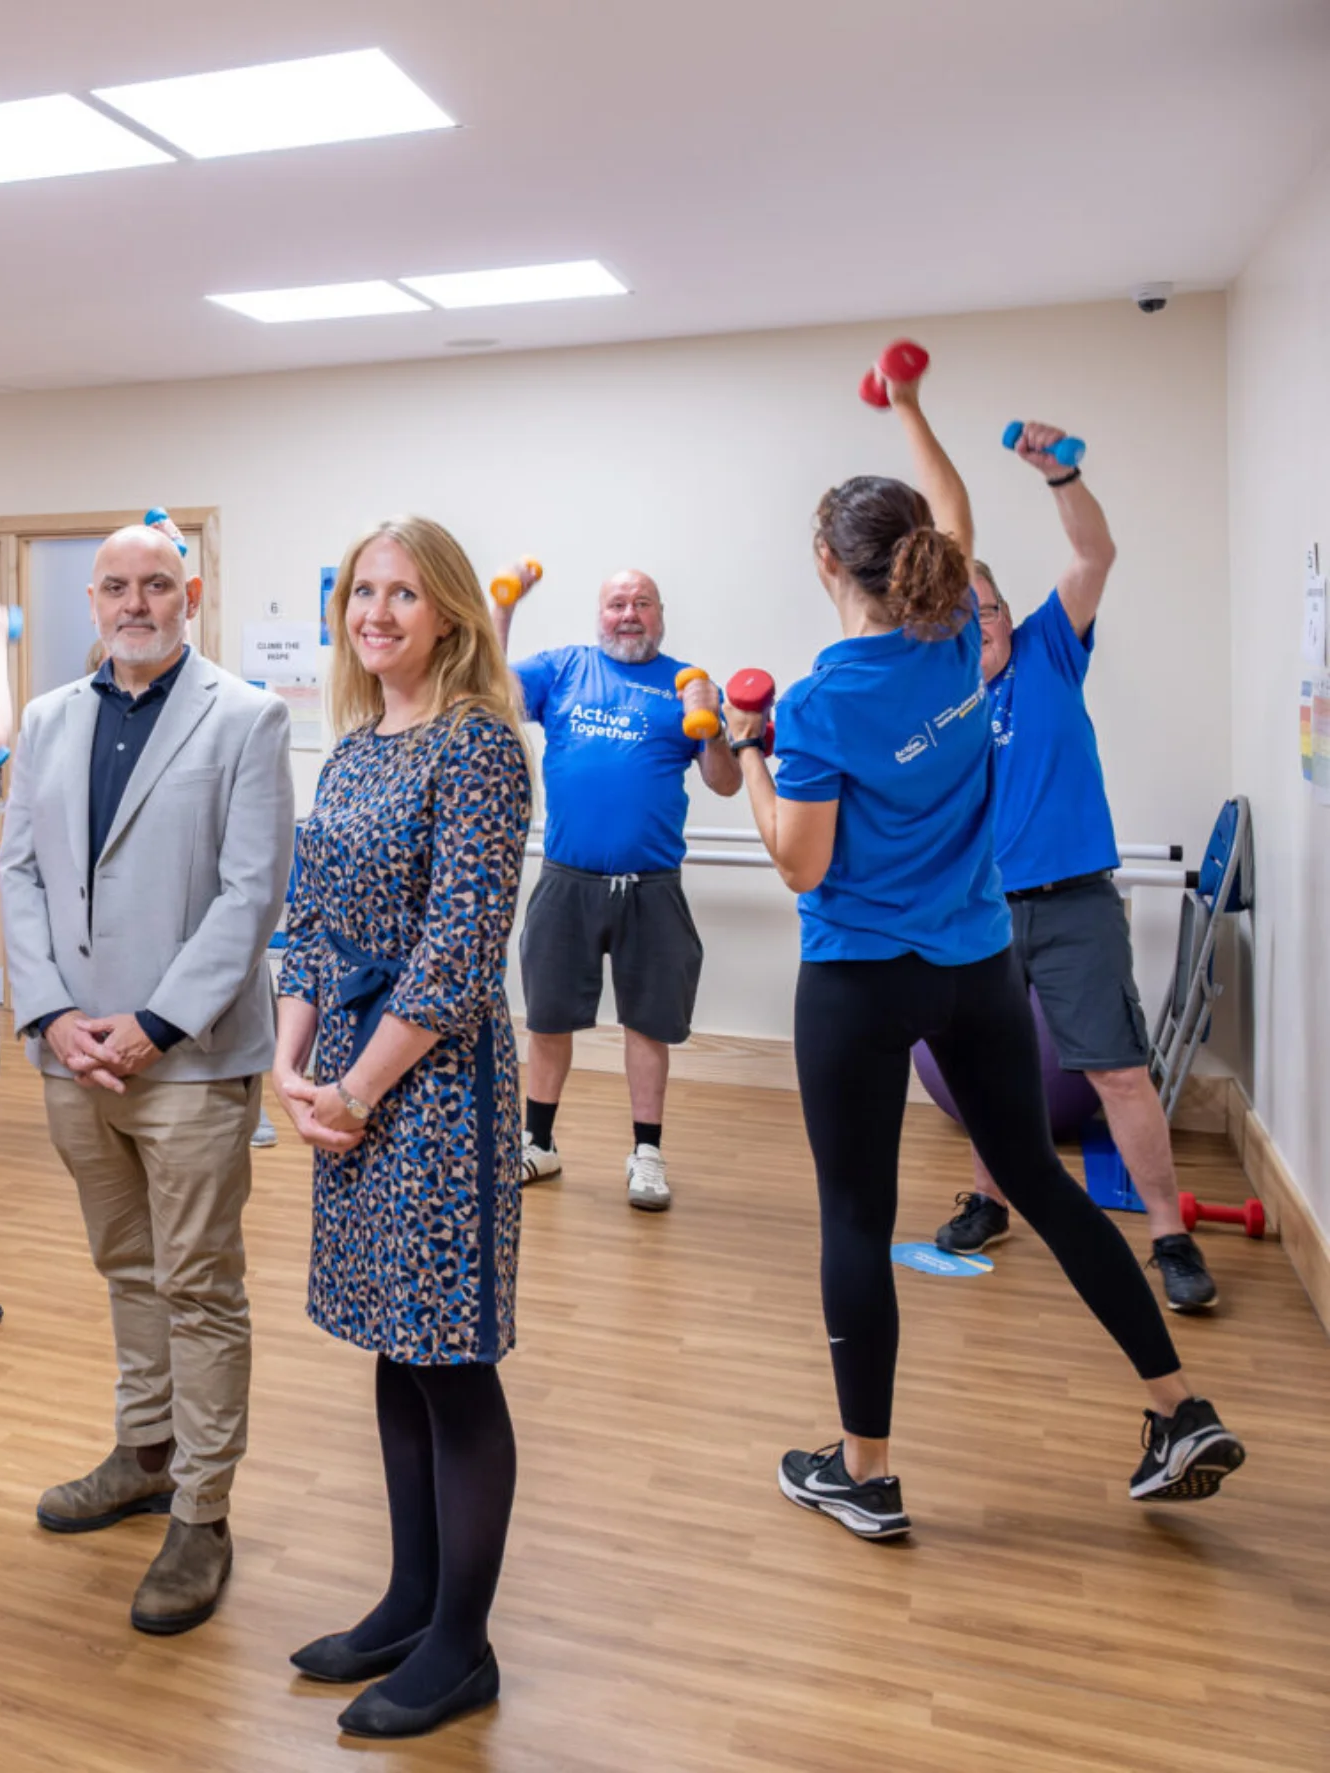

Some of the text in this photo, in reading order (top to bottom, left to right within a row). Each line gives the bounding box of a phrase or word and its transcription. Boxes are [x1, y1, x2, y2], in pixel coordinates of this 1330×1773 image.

[270, 602, 279, 614] 6
[285, 641, 300, 650] THE
[570, 704, 631, 728] Active
